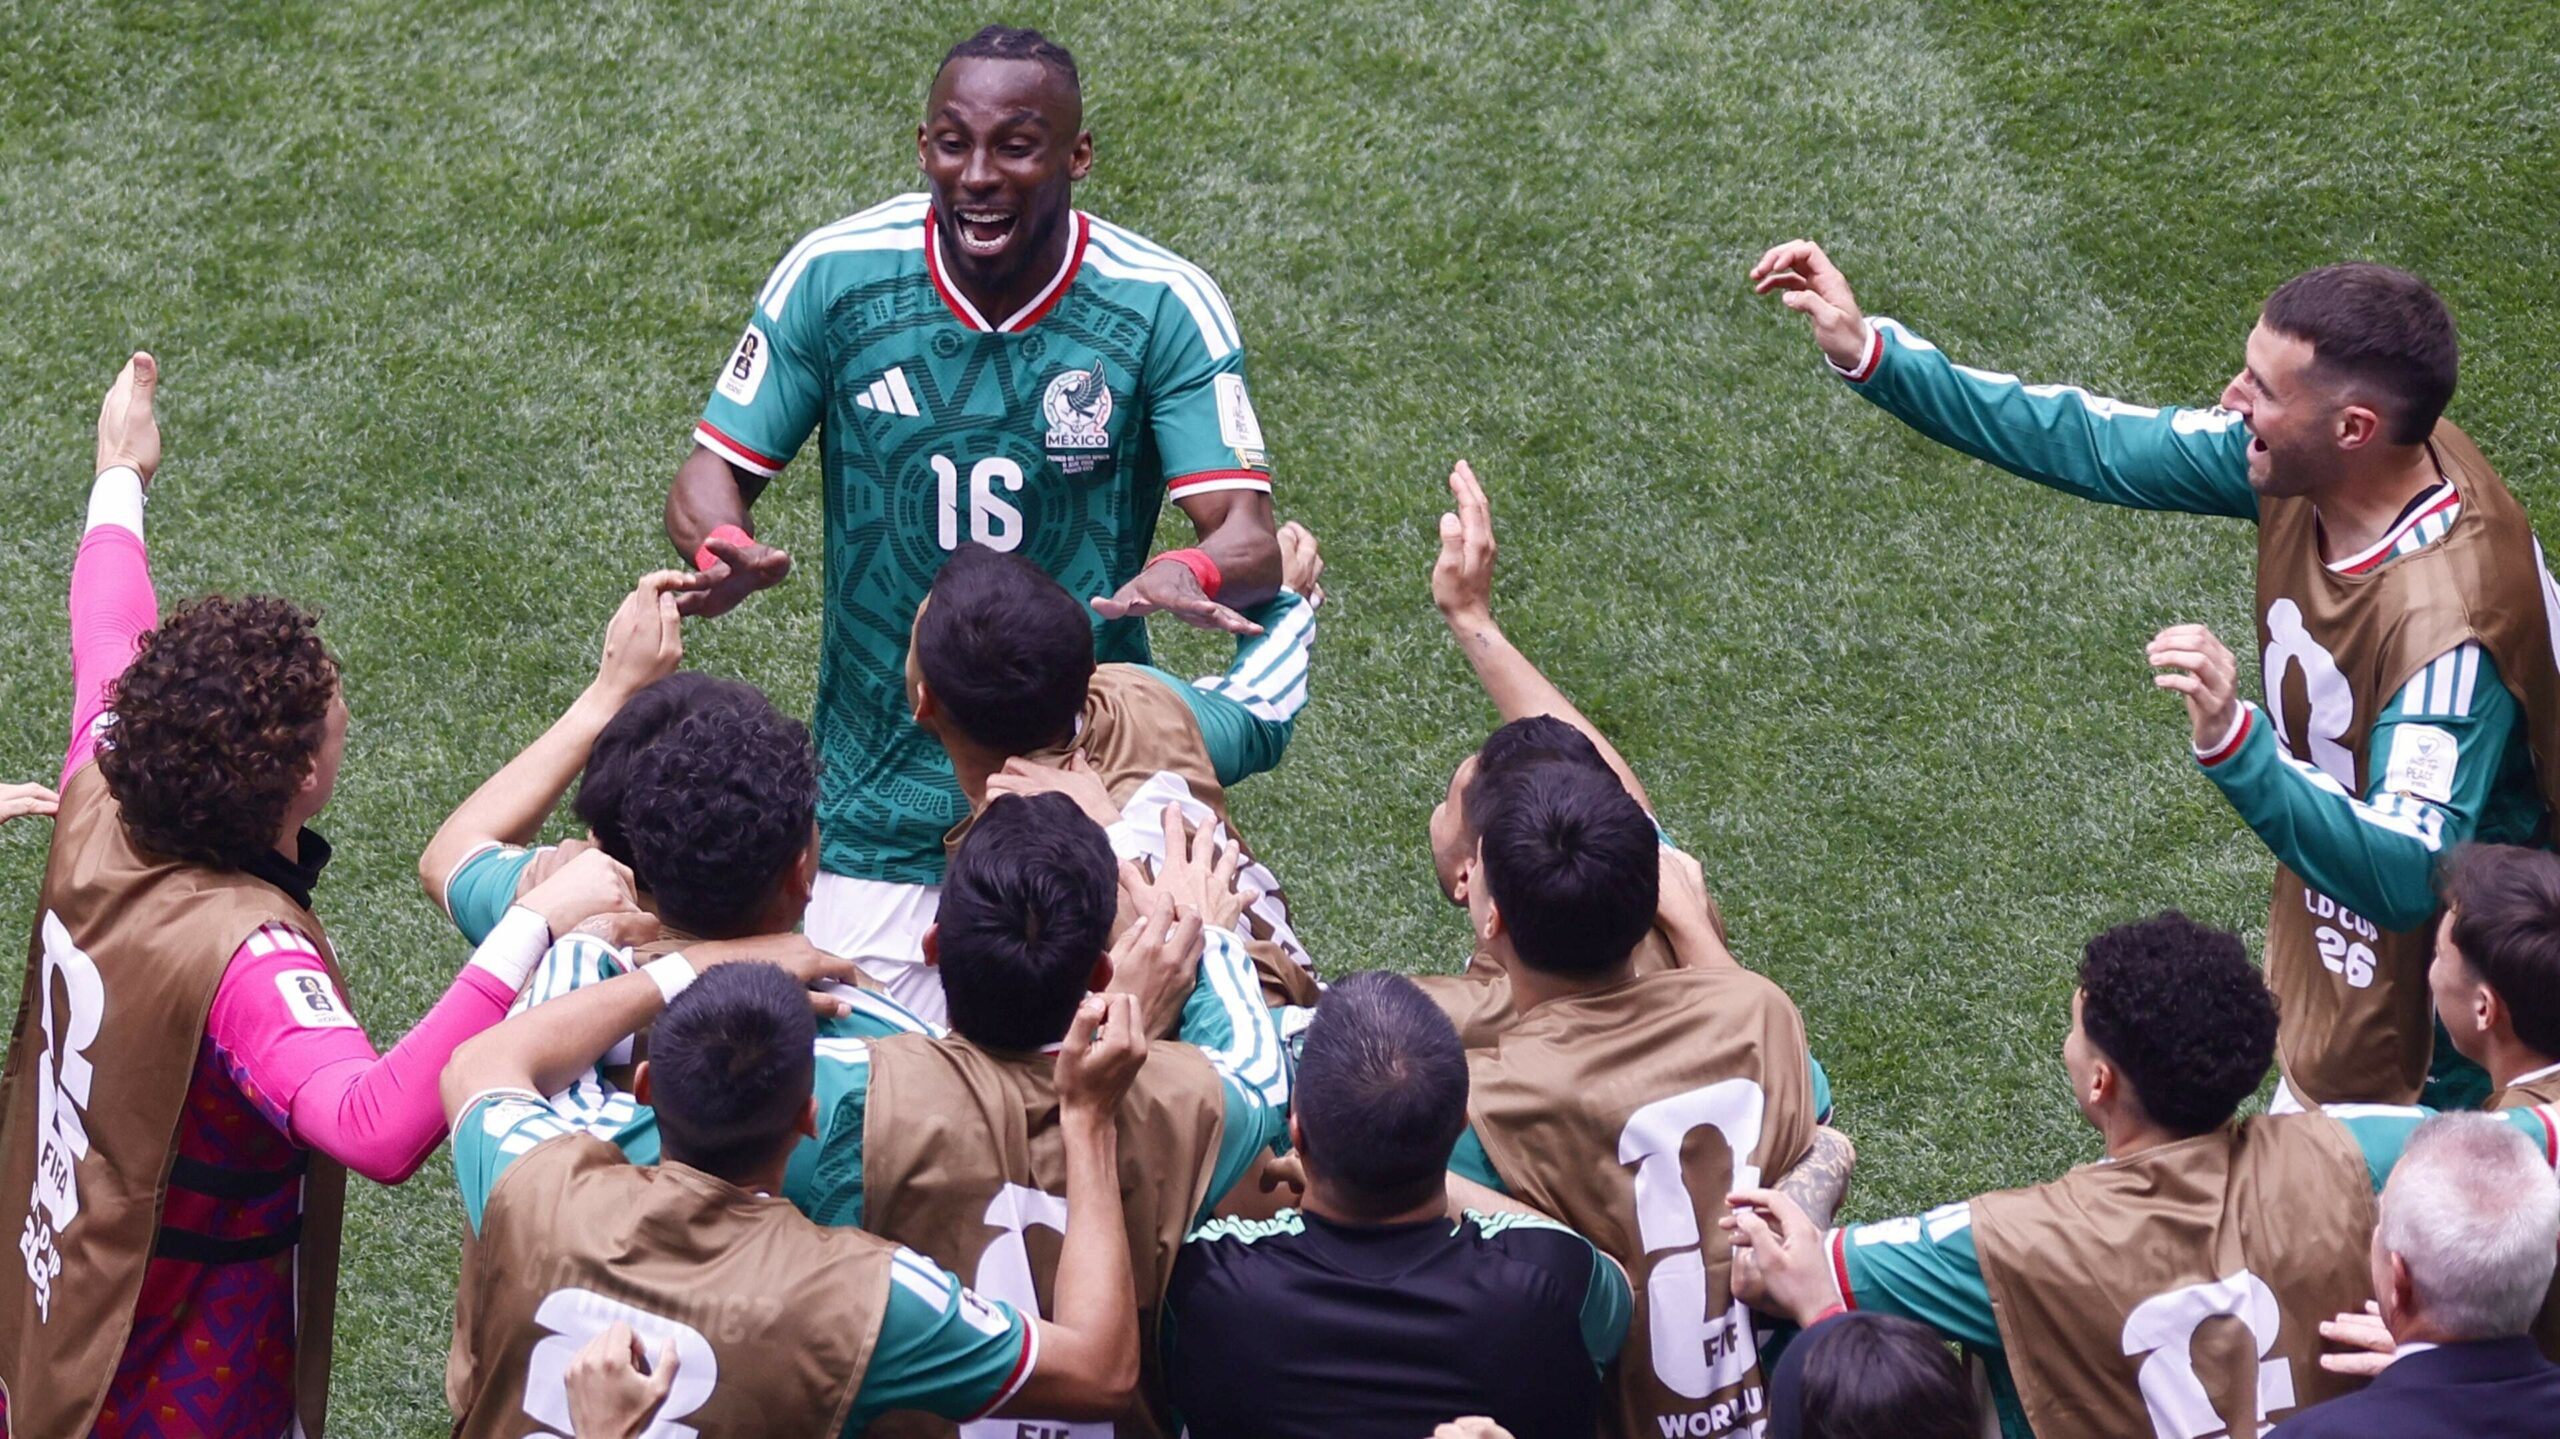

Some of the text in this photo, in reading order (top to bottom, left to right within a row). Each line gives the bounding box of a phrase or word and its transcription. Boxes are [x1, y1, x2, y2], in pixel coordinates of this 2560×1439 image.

[1048, 432, 1106, 446] MÉXICO
[930, 453, 1024, 553] 16
[2314, 925, 2377, 989] 26
[40, 1139, 68, 1200] FIFA
[1702, 1321, 1739, 1368] FIF
